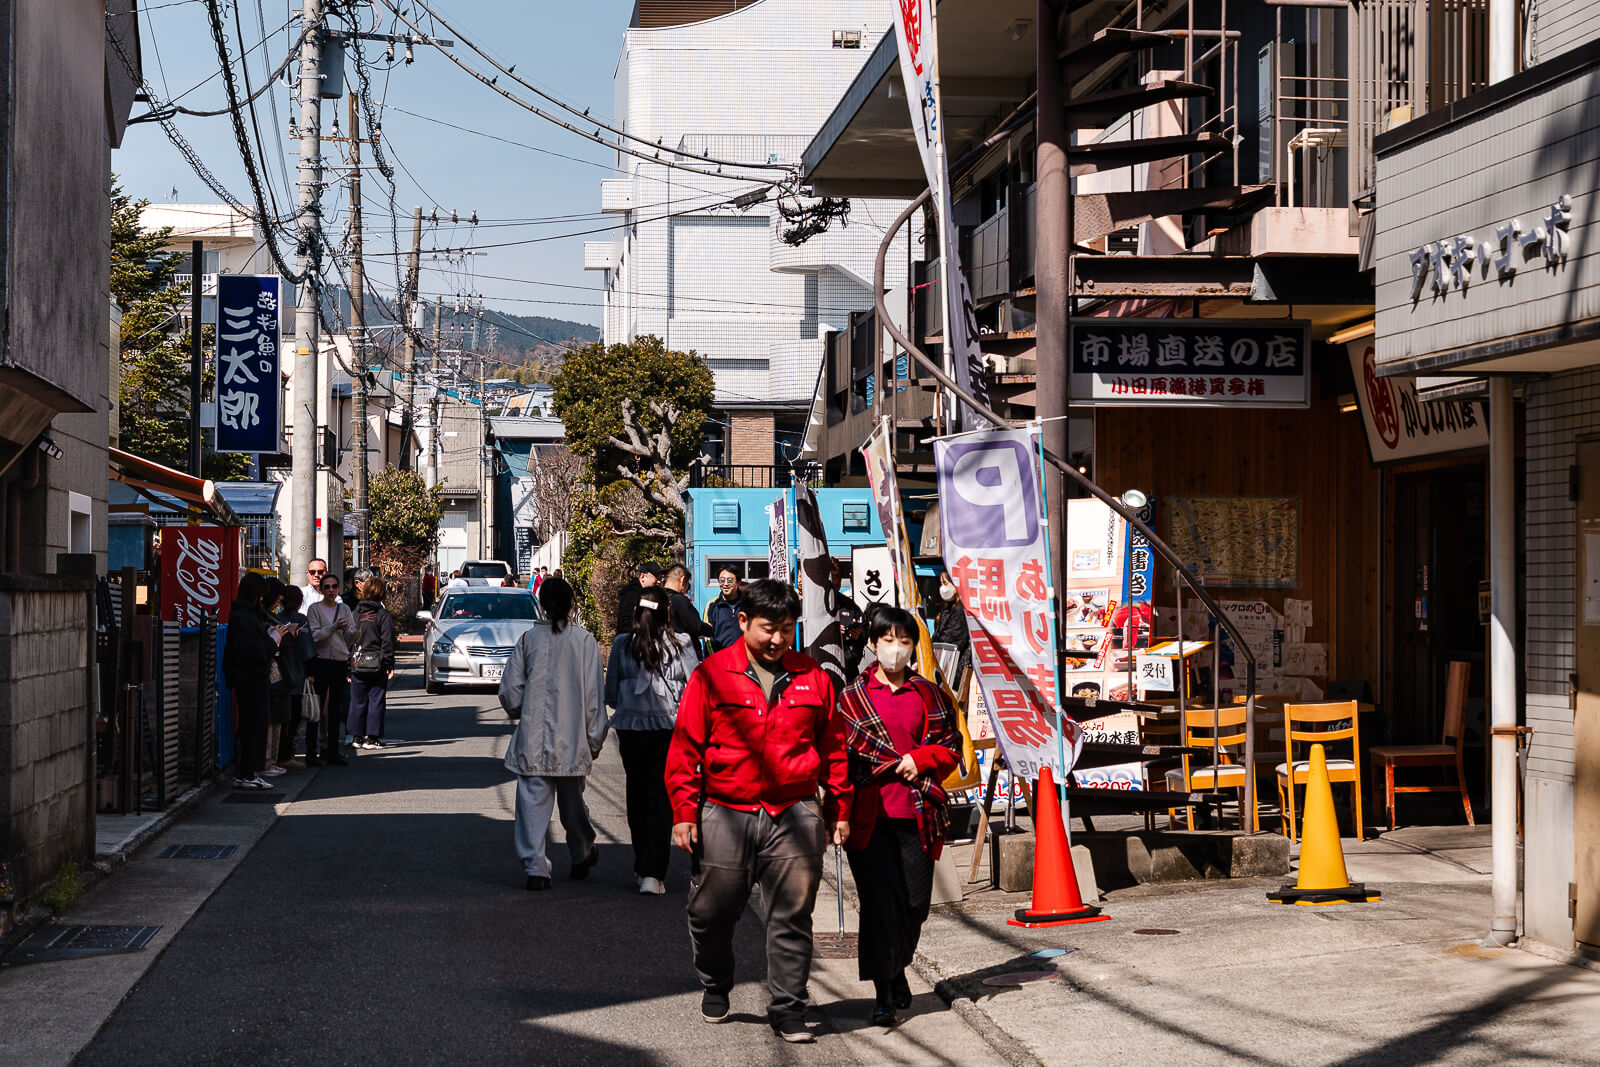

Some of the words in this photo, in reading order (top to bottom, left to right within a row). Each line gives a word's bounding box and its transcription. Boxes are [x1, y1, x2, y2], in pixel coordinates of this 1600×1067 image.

[1080, 333, 1298, 368] 市場直送の店
[220, 306, 259, 430] 三太郎
[1112, 376, 1266, 396] 小田原漁港買参権
[1142, 663, 1166, 679] 受付
